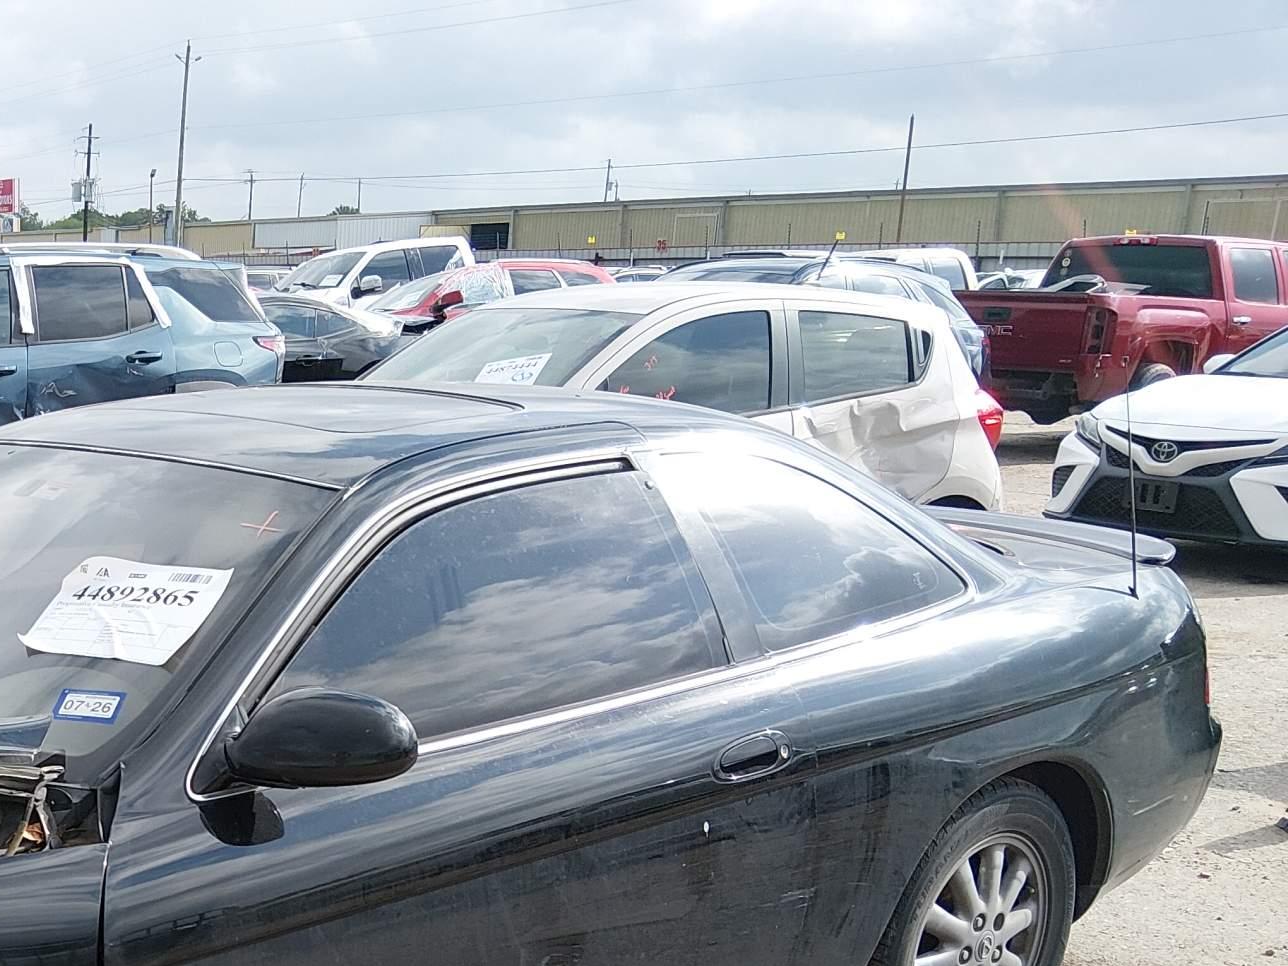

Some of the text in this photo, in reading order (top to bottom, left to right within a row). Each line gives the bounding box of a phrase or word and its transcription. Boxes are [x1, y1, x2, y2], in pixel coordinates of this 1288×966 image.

[72, 584, 200, 607] 44892865
[63, 699, 112, 713] 07 26
